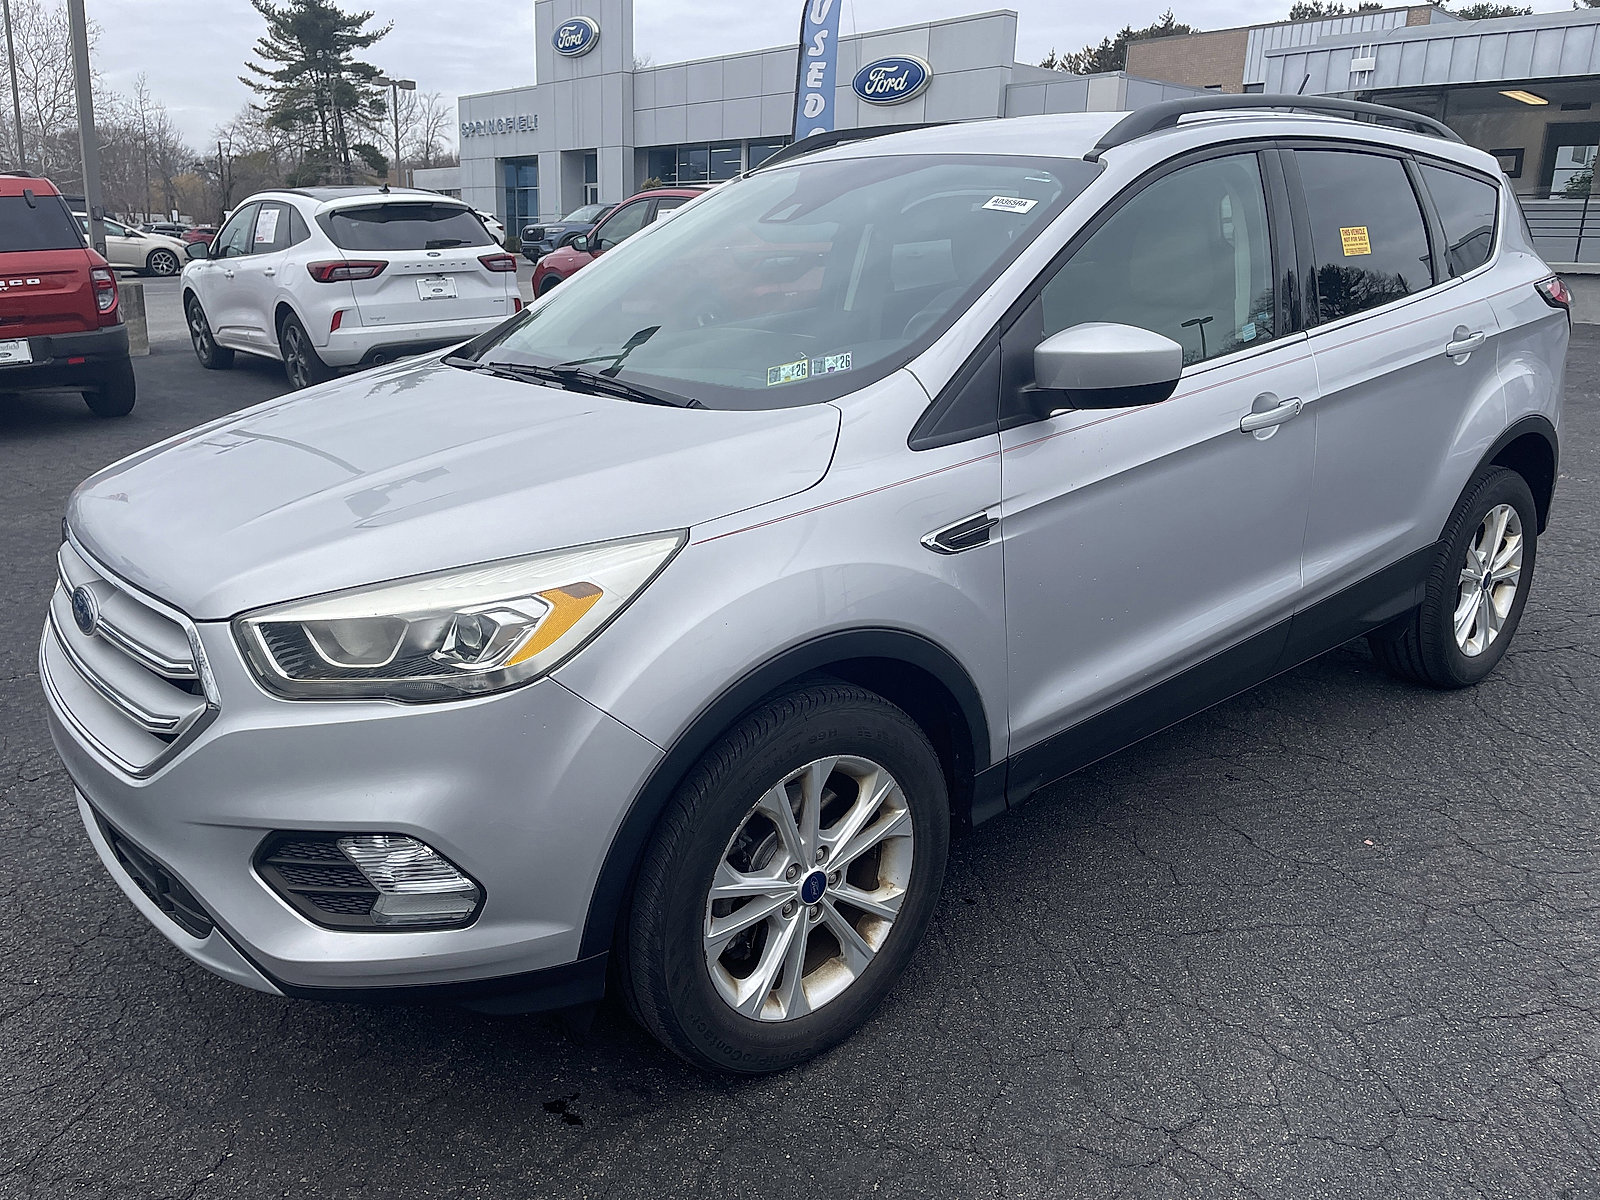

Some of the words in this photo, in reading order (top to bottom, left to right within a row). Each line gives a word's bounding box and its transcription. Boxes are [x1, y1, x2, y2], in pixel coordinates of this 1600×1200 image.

[557, 25, 584, 49] Ford
[803, 0, 832, 118] USED
[864, 65, 909, 95] Ford
[796, 363, 806, 376] 26
[840, 354, 850, 368] 26
